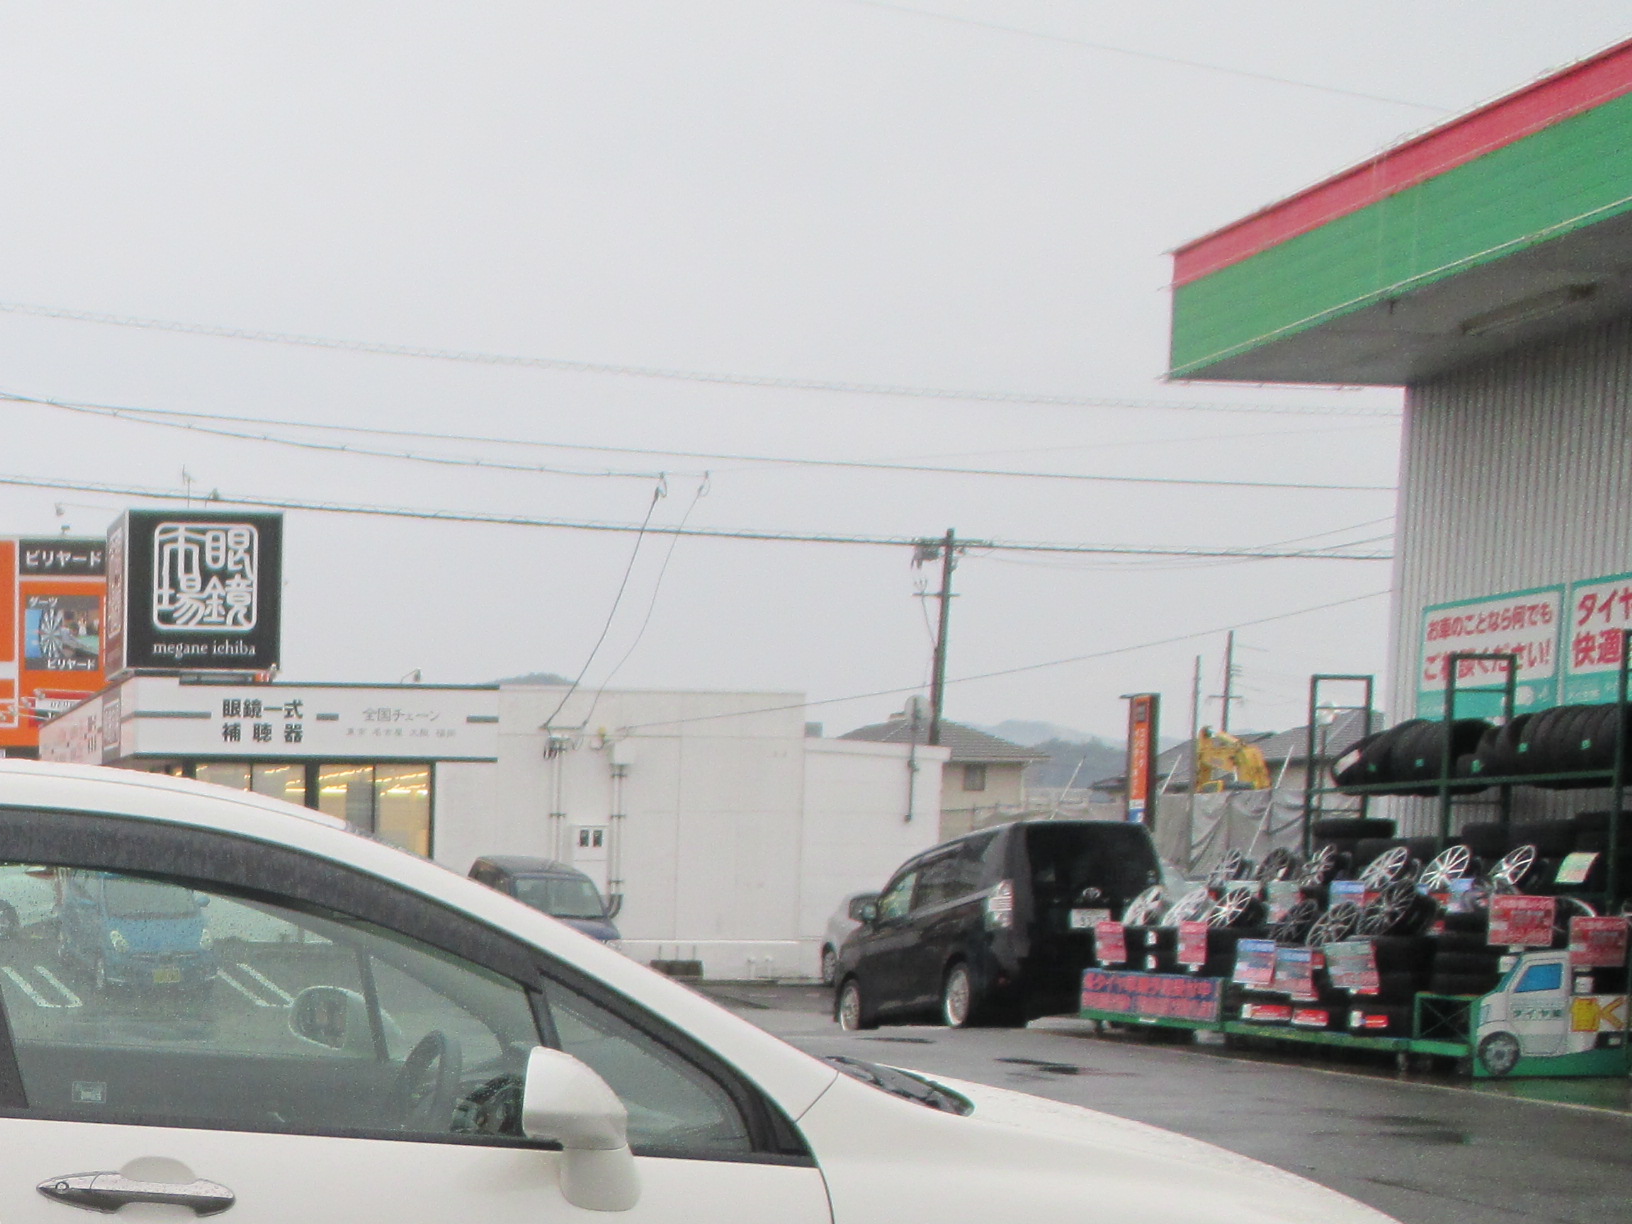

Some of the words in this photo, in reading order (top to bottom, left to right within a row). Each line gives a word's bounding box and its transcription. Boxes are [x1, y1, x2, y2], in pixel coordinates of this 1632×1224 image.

[25, 550, 103, 567] ビリヤード
[28, 596, 59, 608] ダーツ
[153, 642, 209, 659] megane
[212, 639, 257, 656] ichiba
[46, 658, 96, 670] ビリヤード
[221, 698, 305, 719] 眼鏡一式
[362, 707, 441, 722] 全国チェーン
[221, 722, 305, 743] 補聴器
